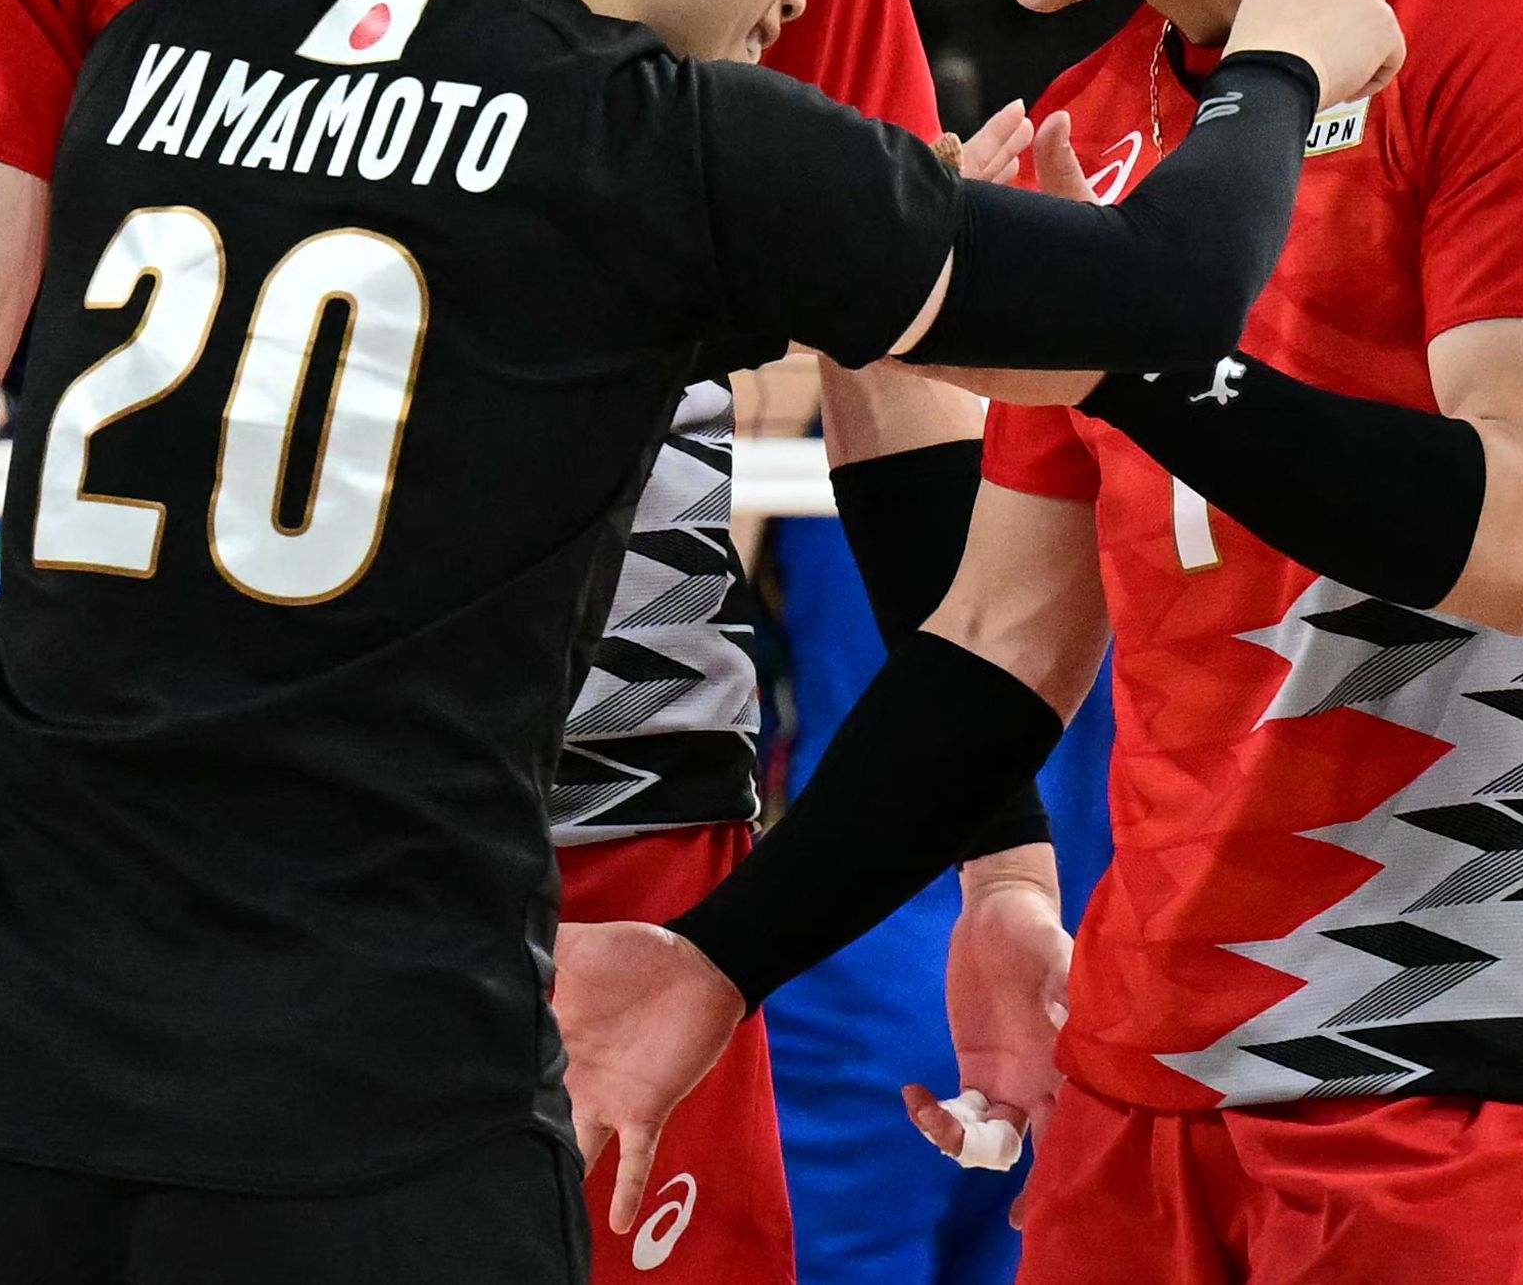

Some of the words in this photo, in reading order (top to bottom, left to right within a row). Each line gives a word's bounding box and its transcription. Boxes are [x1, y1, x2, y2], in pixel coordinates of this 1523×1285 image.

[106, 43, 529, 193] YAMAMOTO
[1306, 117, 1355, 148] JPN
[33, 205, 430, 606] 20
